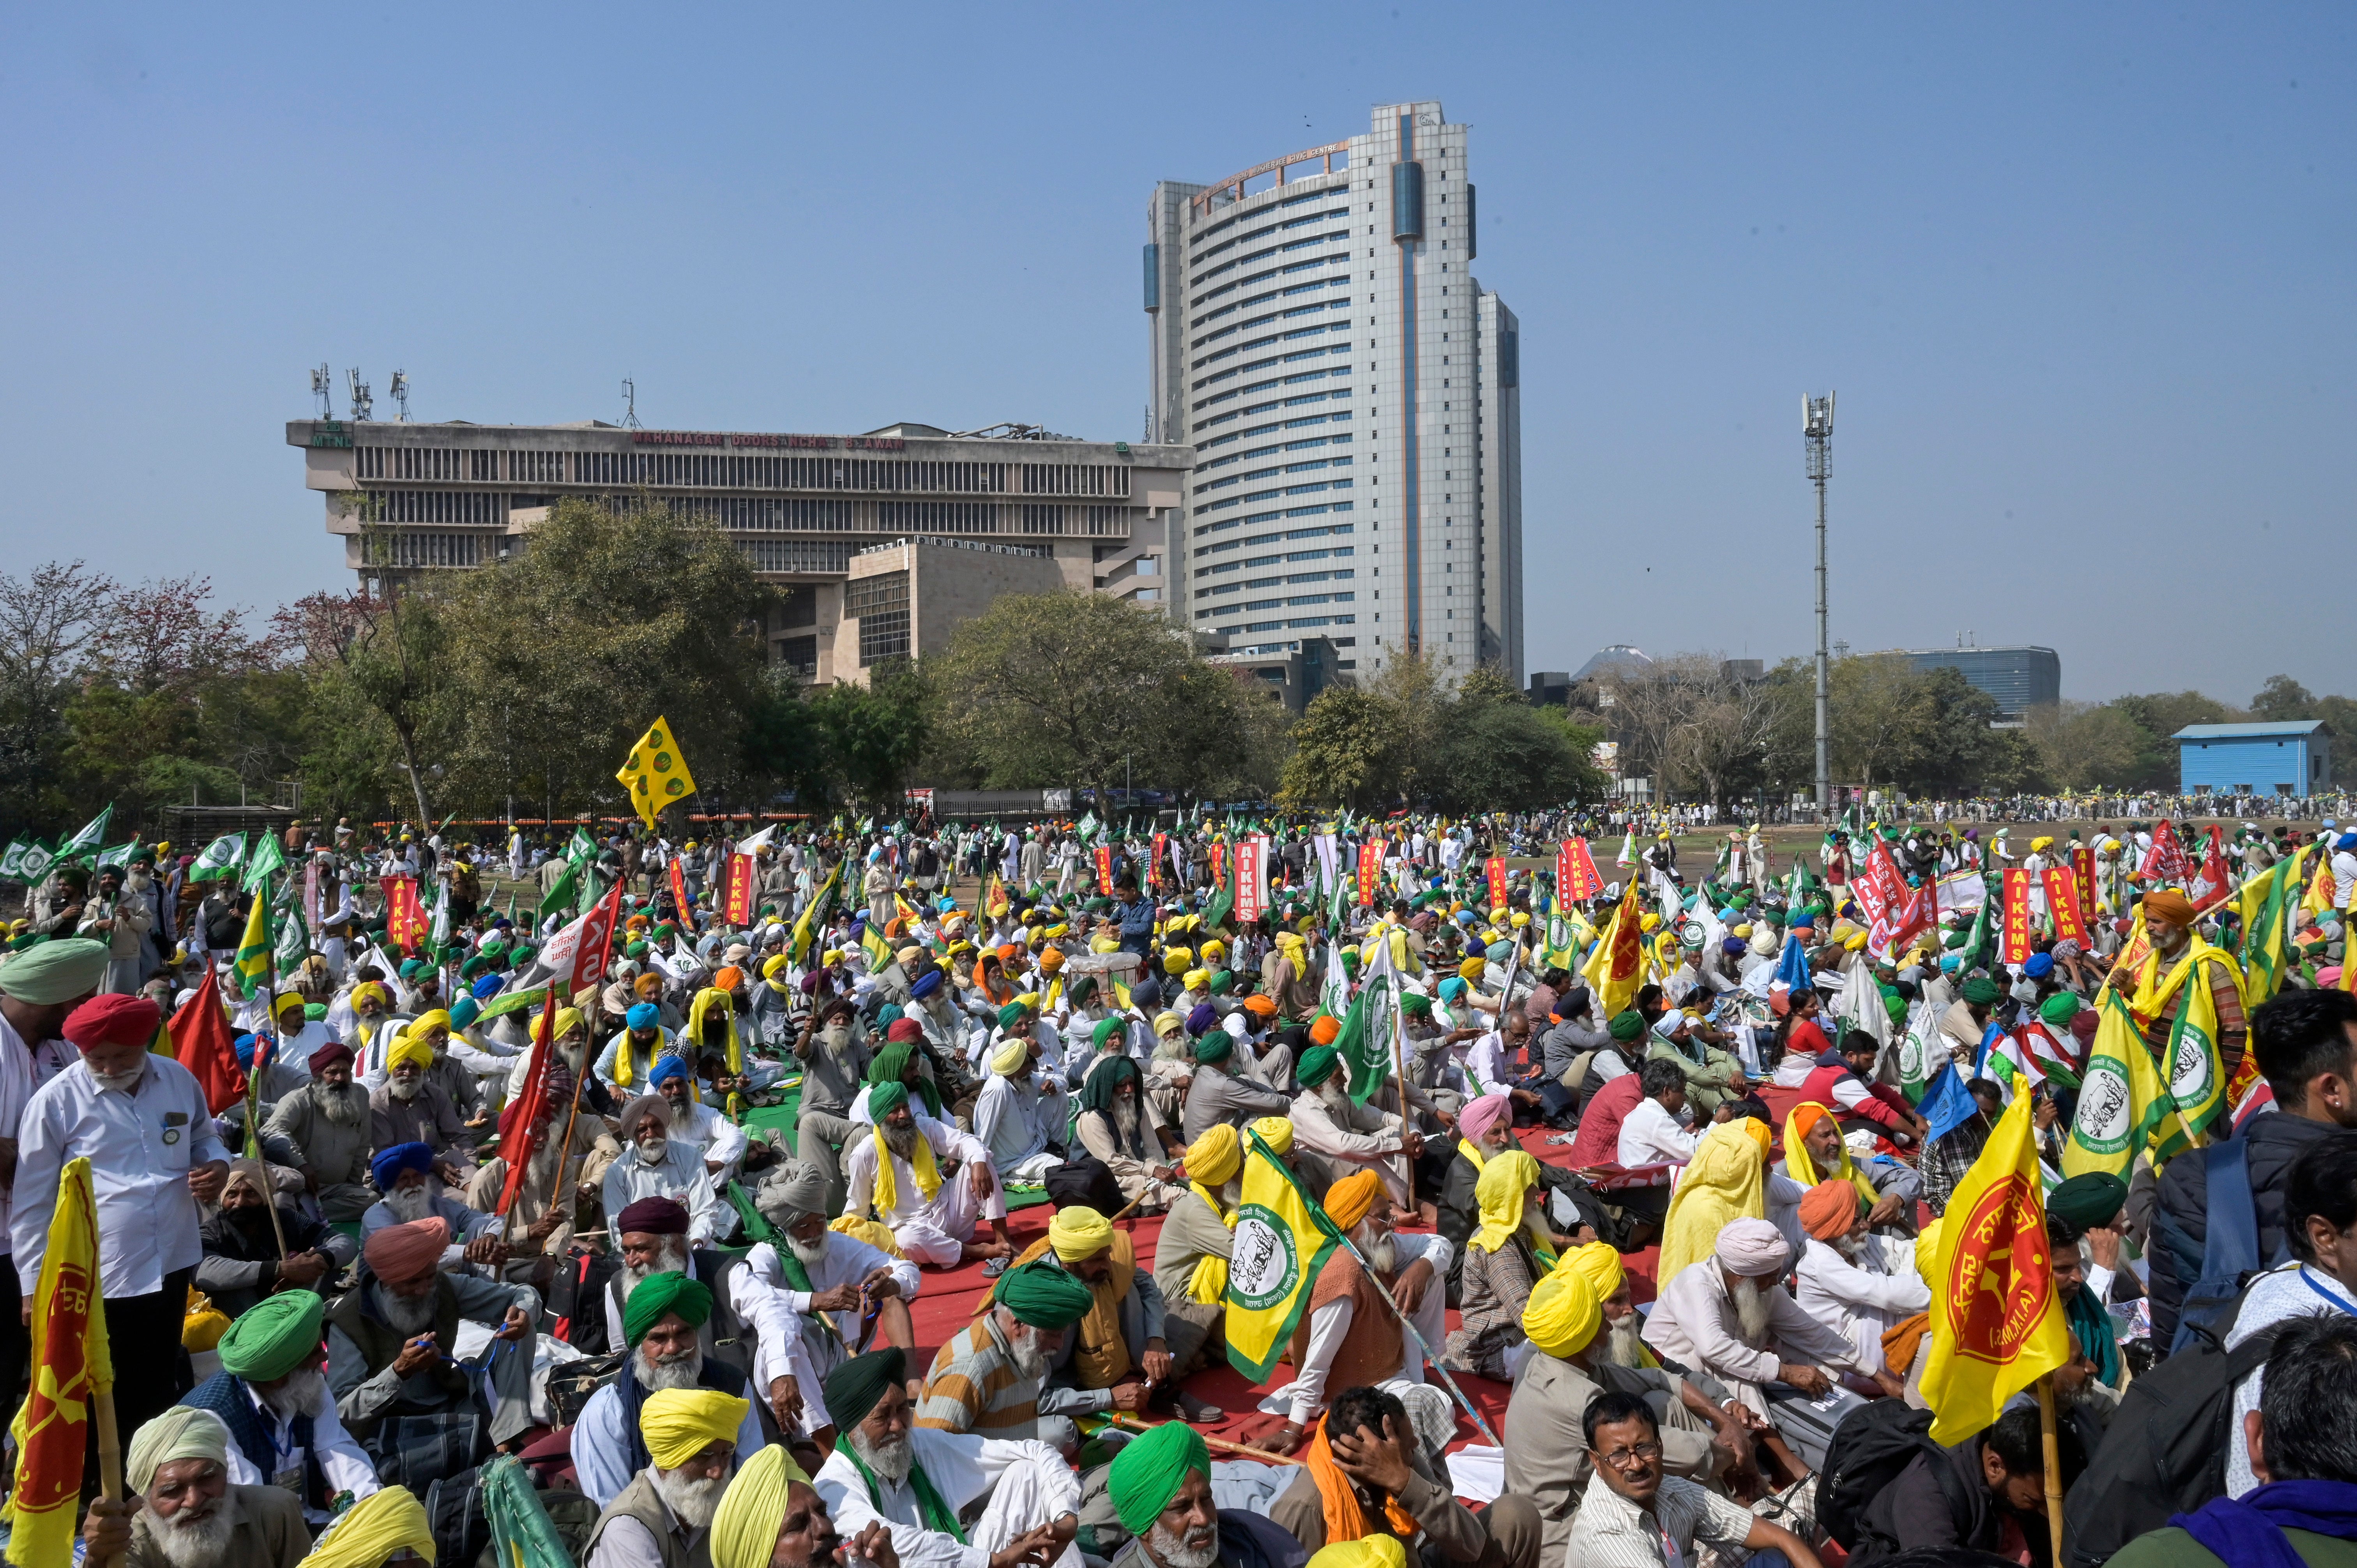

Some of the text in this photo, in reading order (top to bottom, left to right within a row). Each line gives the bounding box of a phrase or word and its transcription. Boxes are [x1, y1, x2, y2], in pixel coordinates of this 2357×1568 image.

[313, 435, 352, 447] MTNL
[633, 432, 905, 449] MAHANAGAR DOORSANCHA BAWAN
[673, 861, 693, 929] AIKKMS
[730, 854, 744, 922] AIKKMS
[1098, 848, 1109, 894] AIKKMS
[1214, 846, 1223, 891] AIKKMS
[1240, 846, 1253, 920] AIKKMS
[1362, 847, 1371, 902] AIKKMS
[1492, 860, 1503, 906] AIKKM
[1570, 841, 1584, 898] AIKKMS
[2011, 871, 2026, 961] AIKKMS
[2050, 871, 2078, 941] AIKKM
